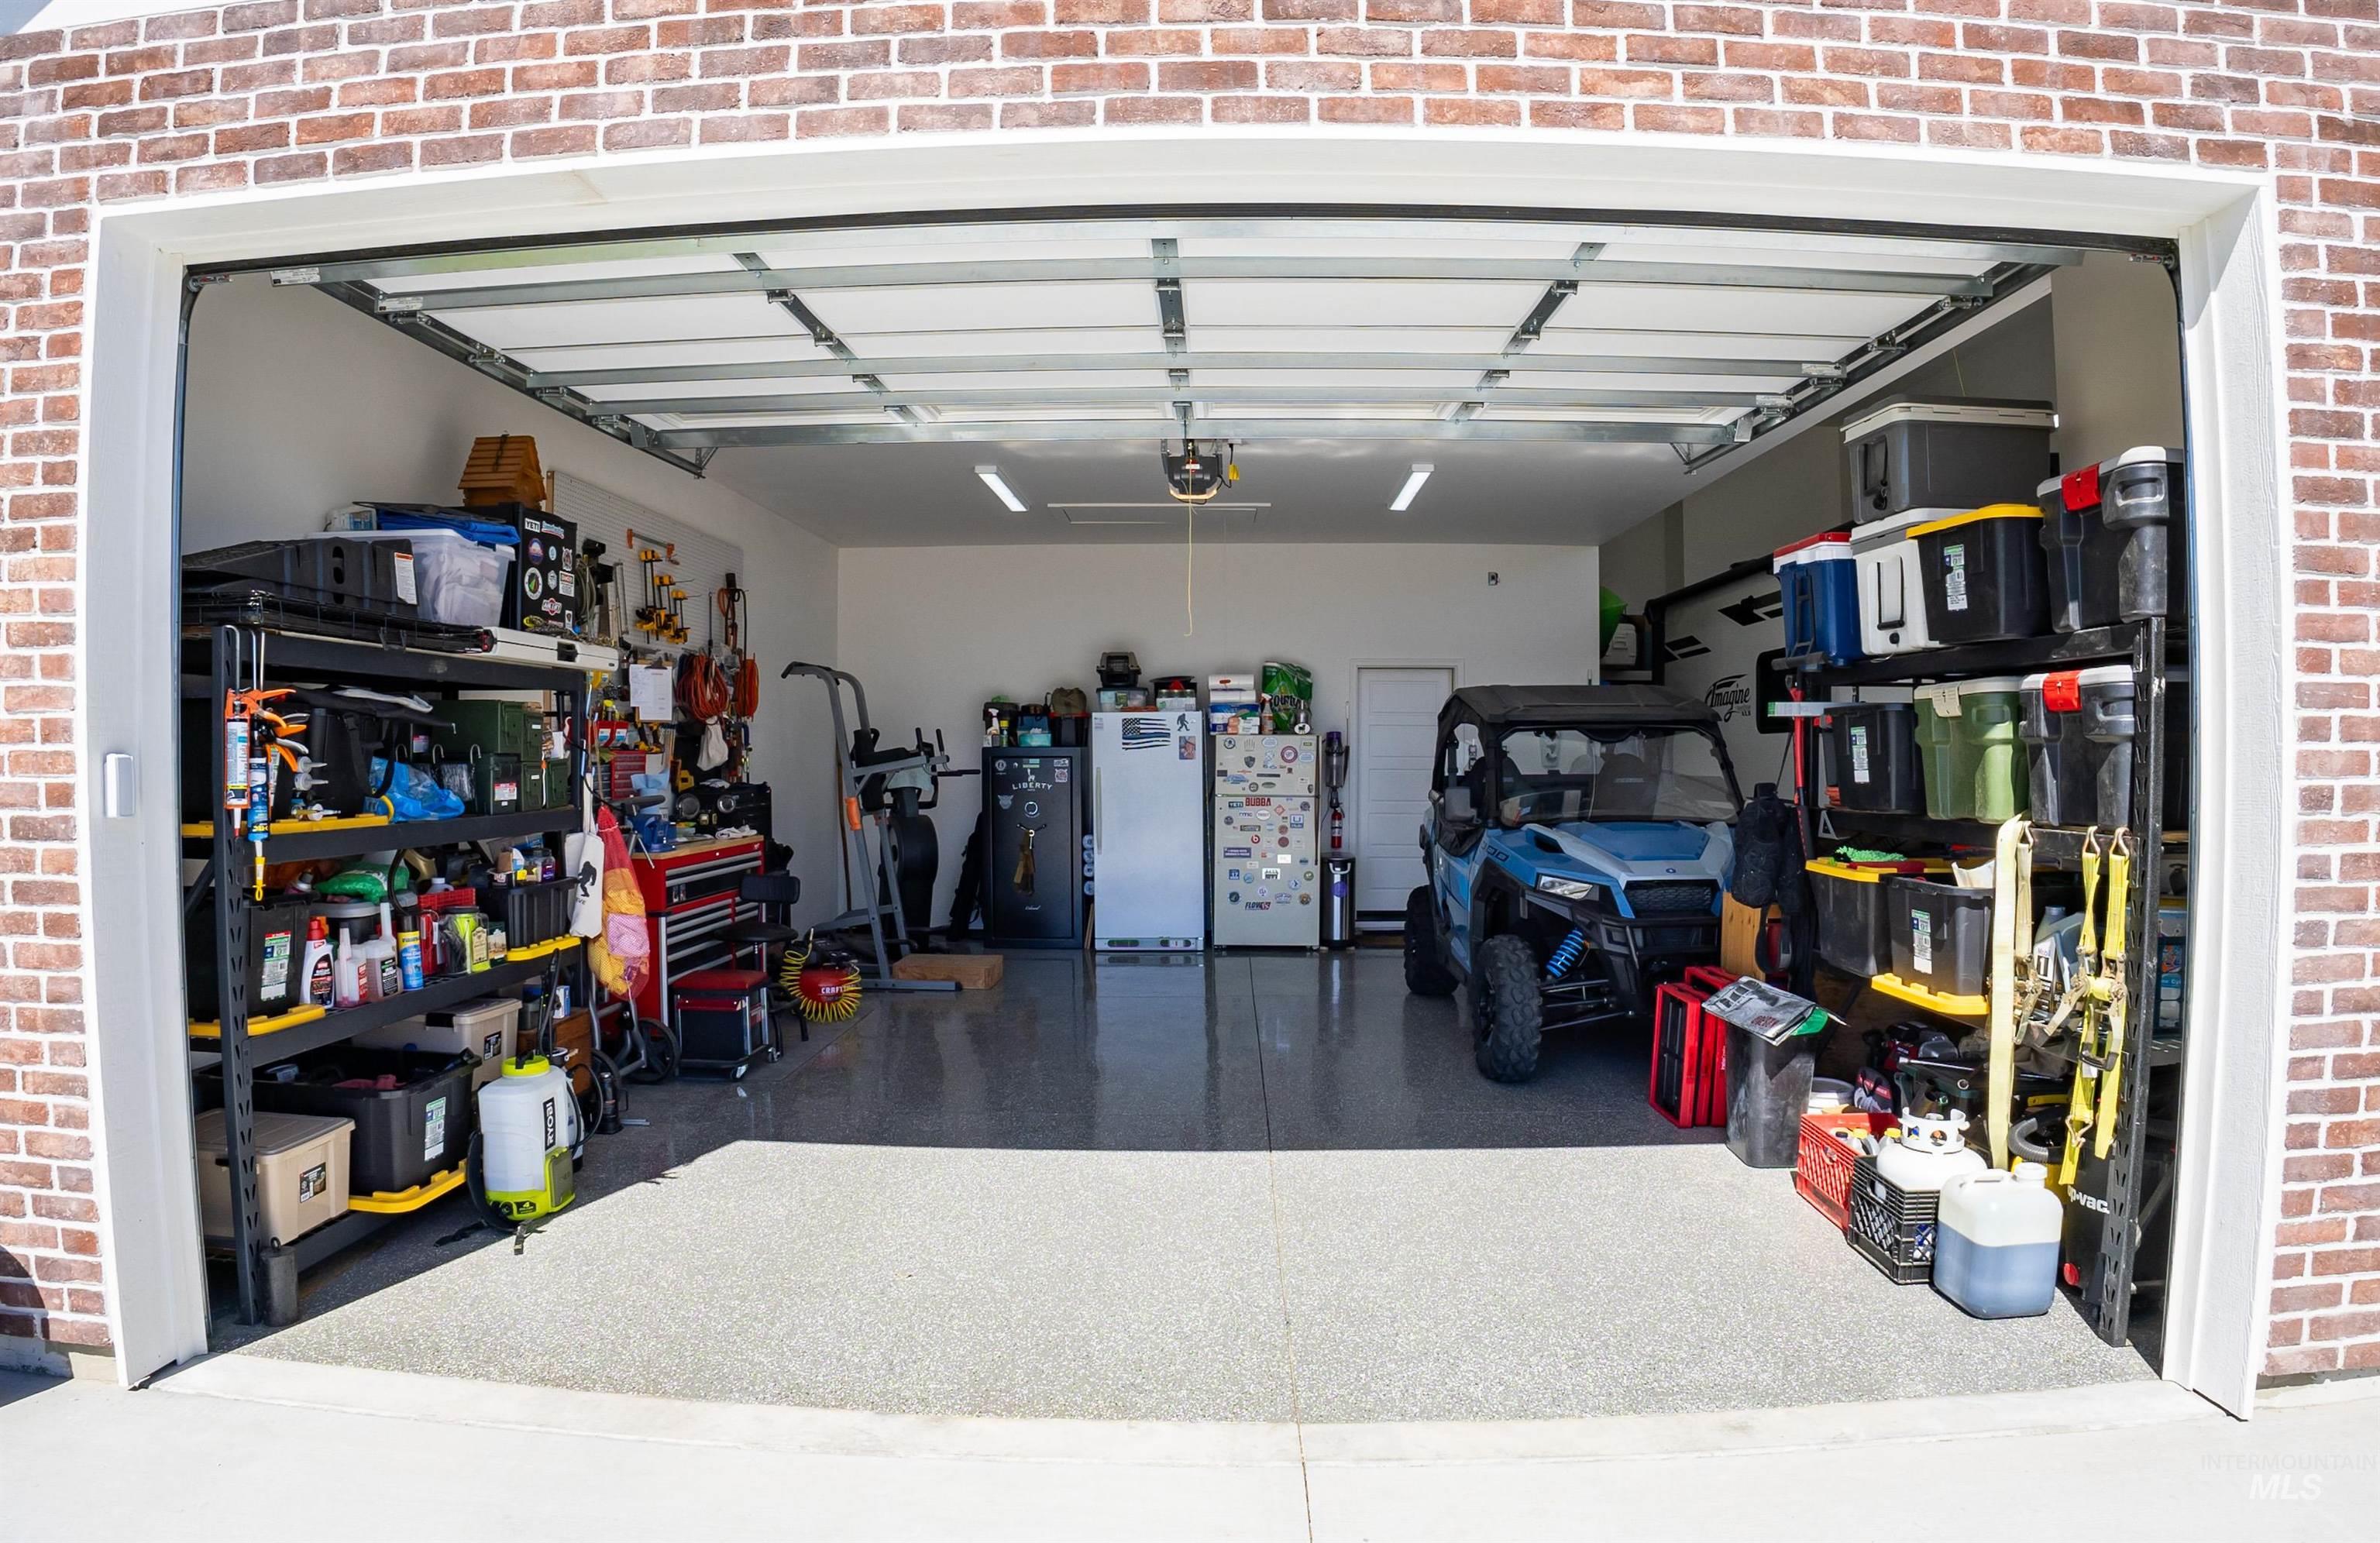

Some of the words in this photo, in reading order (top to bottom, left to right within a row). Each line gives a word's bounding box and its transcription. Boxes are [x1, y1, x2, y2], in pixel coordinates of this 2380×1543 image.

[527, 520, 540, 531] YETI
[1705, 674, 1751, 723] Imagine
[1245, 797, 1271, 806] BUBBA
[545, 1101, 554, 1146] RYOBI
